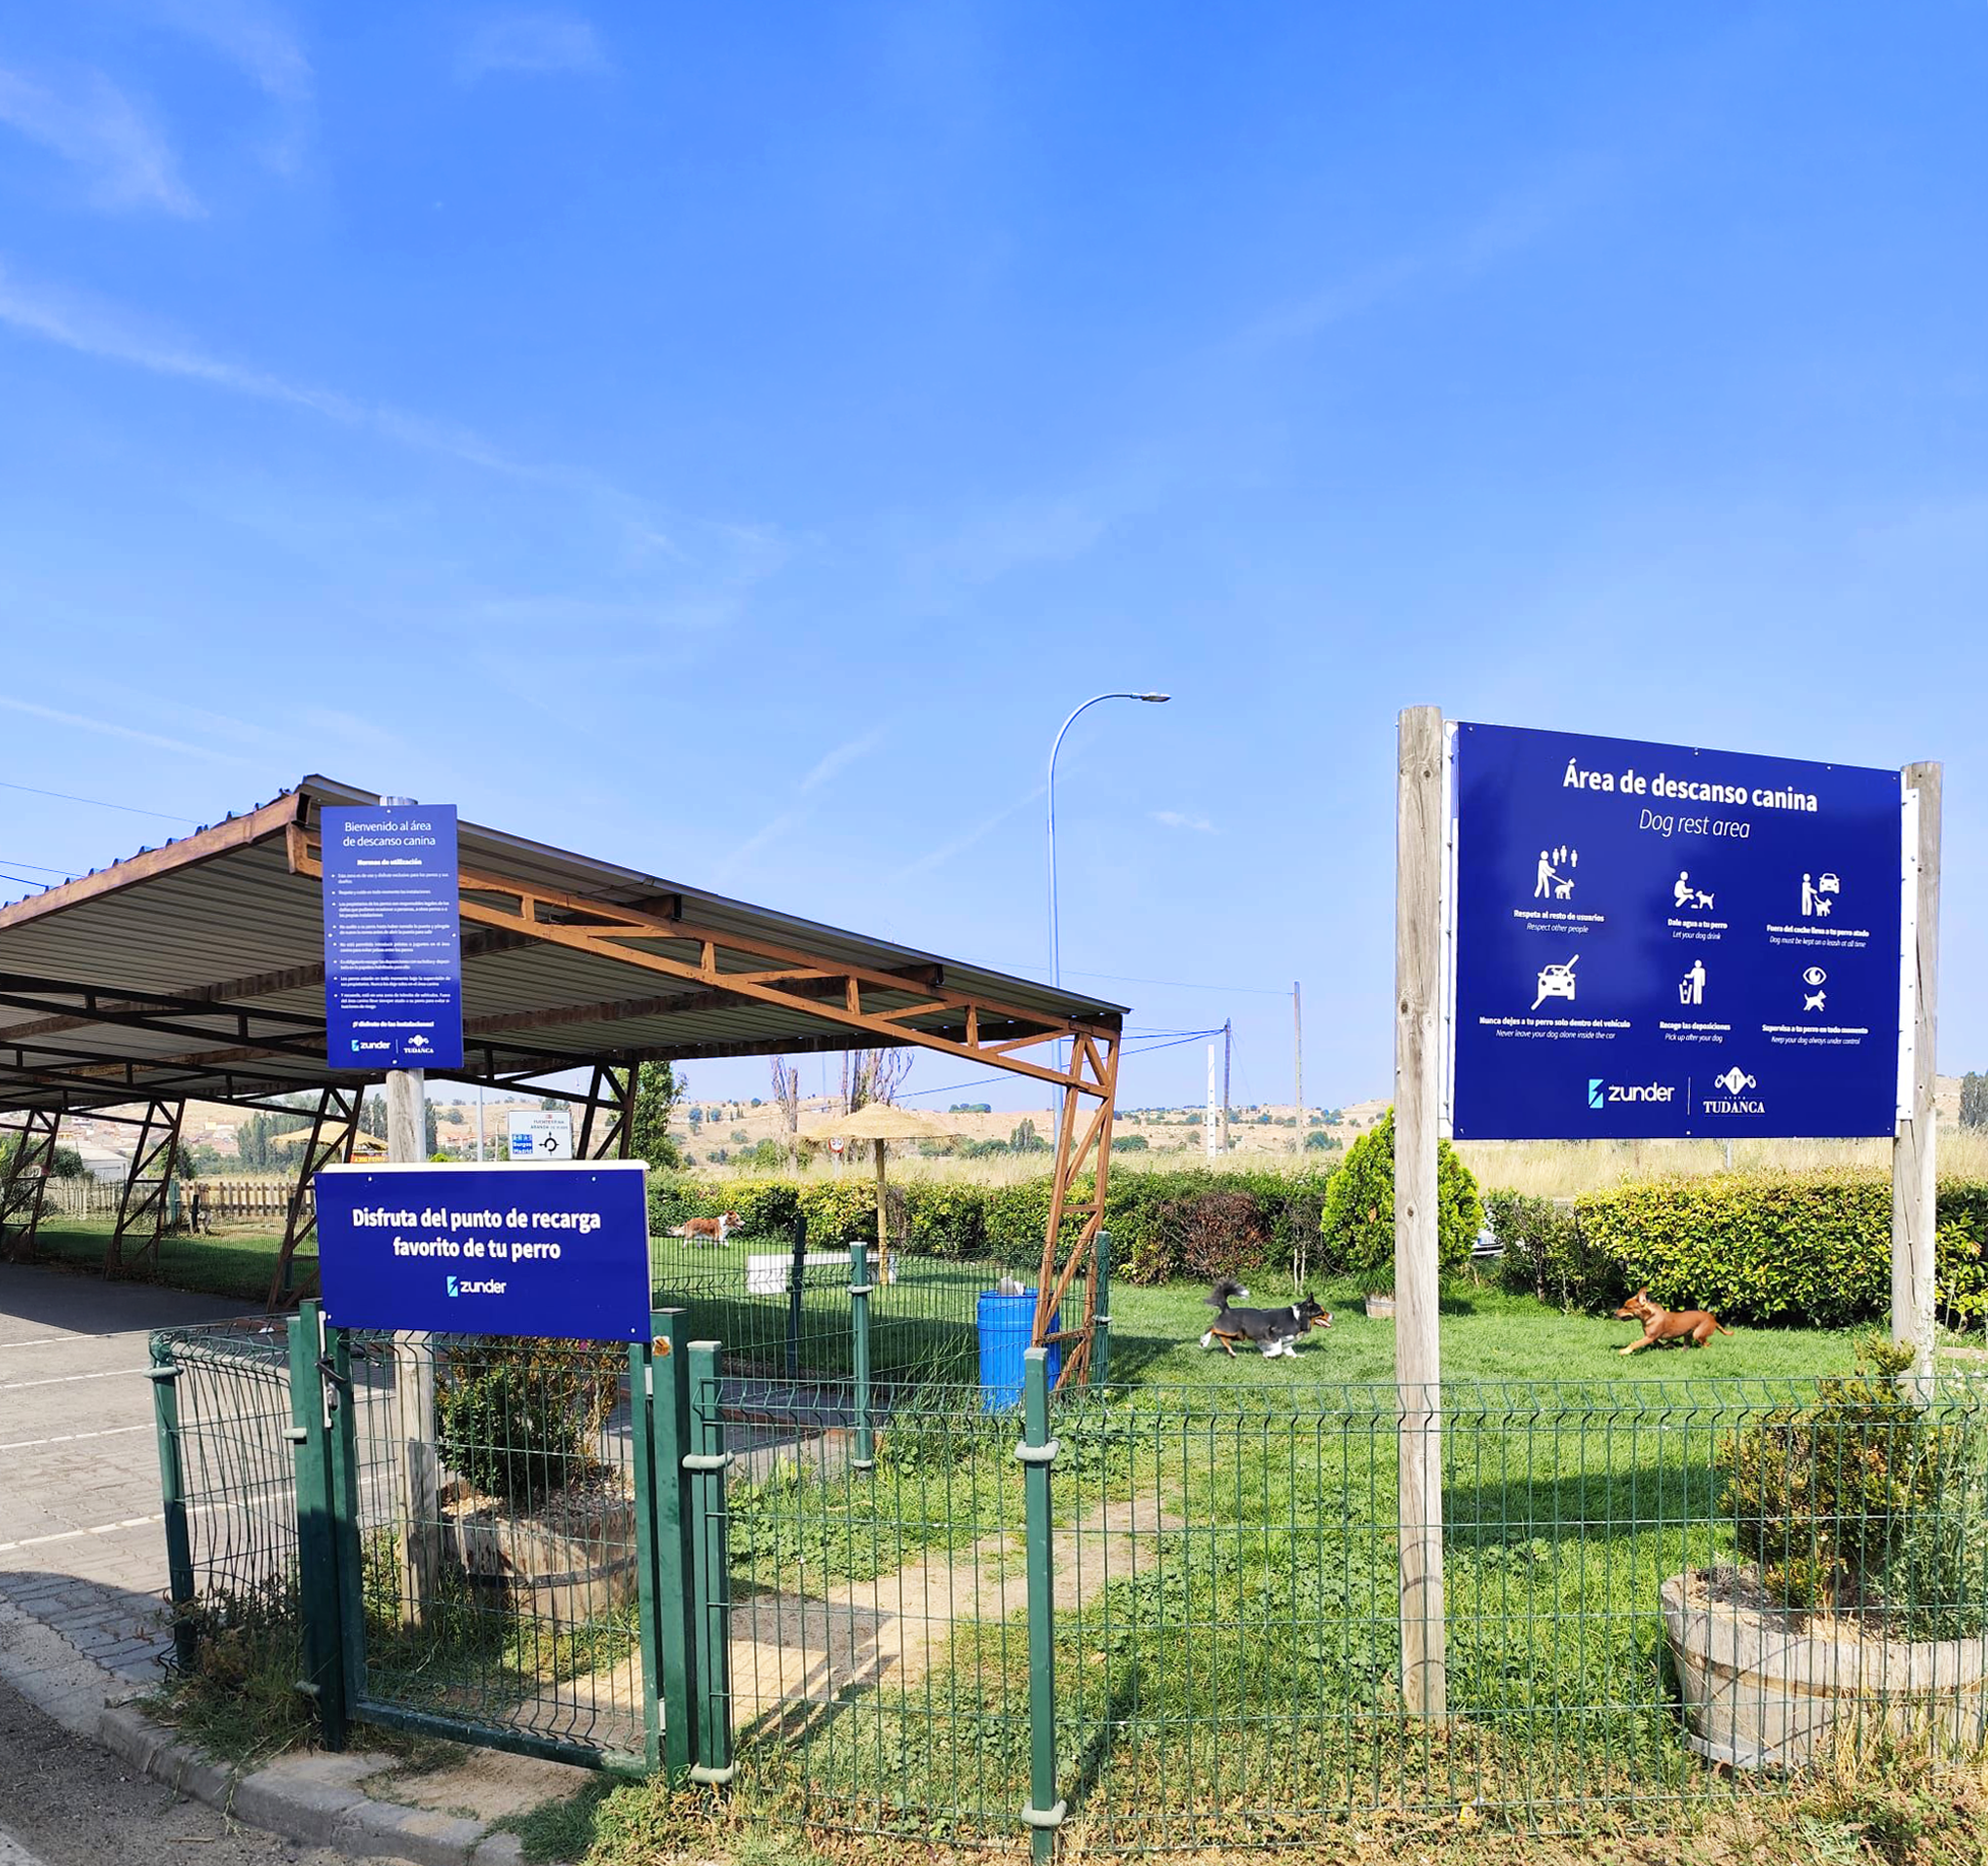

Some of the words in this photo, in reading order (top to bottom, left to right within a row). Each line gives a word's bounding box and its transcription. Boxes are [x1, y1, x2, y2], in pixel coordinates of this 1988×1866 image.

[1563, 758, 1614, 791] Área
[1620, 770, 1647, 794] de
[1652, 773, 1747, 804] descanso
[1752, 786, 1817, 812] canina
[345, 821, 399, 831] Bienvenido
[400, 820, 408, 830] al
[410, 820, 431, 830] área
[1639, 809, 1674, 836] Dog
[1678, 817, 1709, 835] rest
[1713, 820, 1750, 838] area
[343, 836, 356, 846] de
[357, 836, 401, 846] descanso
[403, 836, 436, 846] canina
[1513, 910, 1542, 919] Respeta
[1527, 923, 1551, 932] Respect
[1568, 926, 1588, 934] people
[1696, 932, 1706, 941] dog
[1770, 935, 1781, 945] Dog
[1660, 1021, 1682, 1031] Recoge
[1691, 1022, 1731, 1031] deposiciones
[1762, 1024, 1791, 1033] Supervisa
[1547, 1031, 1559, 1040] dog
[1711, 1034, 1723, 1043] dog
[1797, 1037, 1809, 1046] dog
[1608, 1082, 1675, 1101] zunder
[1703, 1101, 1765, 1113] TUDANCA
[353, 1207, 417, 1227] Disfruta
[421, 1208, 448, 1227] del
[450, 1210, 503, 1232] punto
[506, 1208, 528, 1228] de
[532, 1213, 600, 1234] recarga
[393, 1237, 460, 1257] favorito
[463, 1238, 485, 1257] de
[487, 1239, 507, 1257] tu
[512, 1243, 561, 1263] perro
[460, 1278, 507, 1294] zunder
